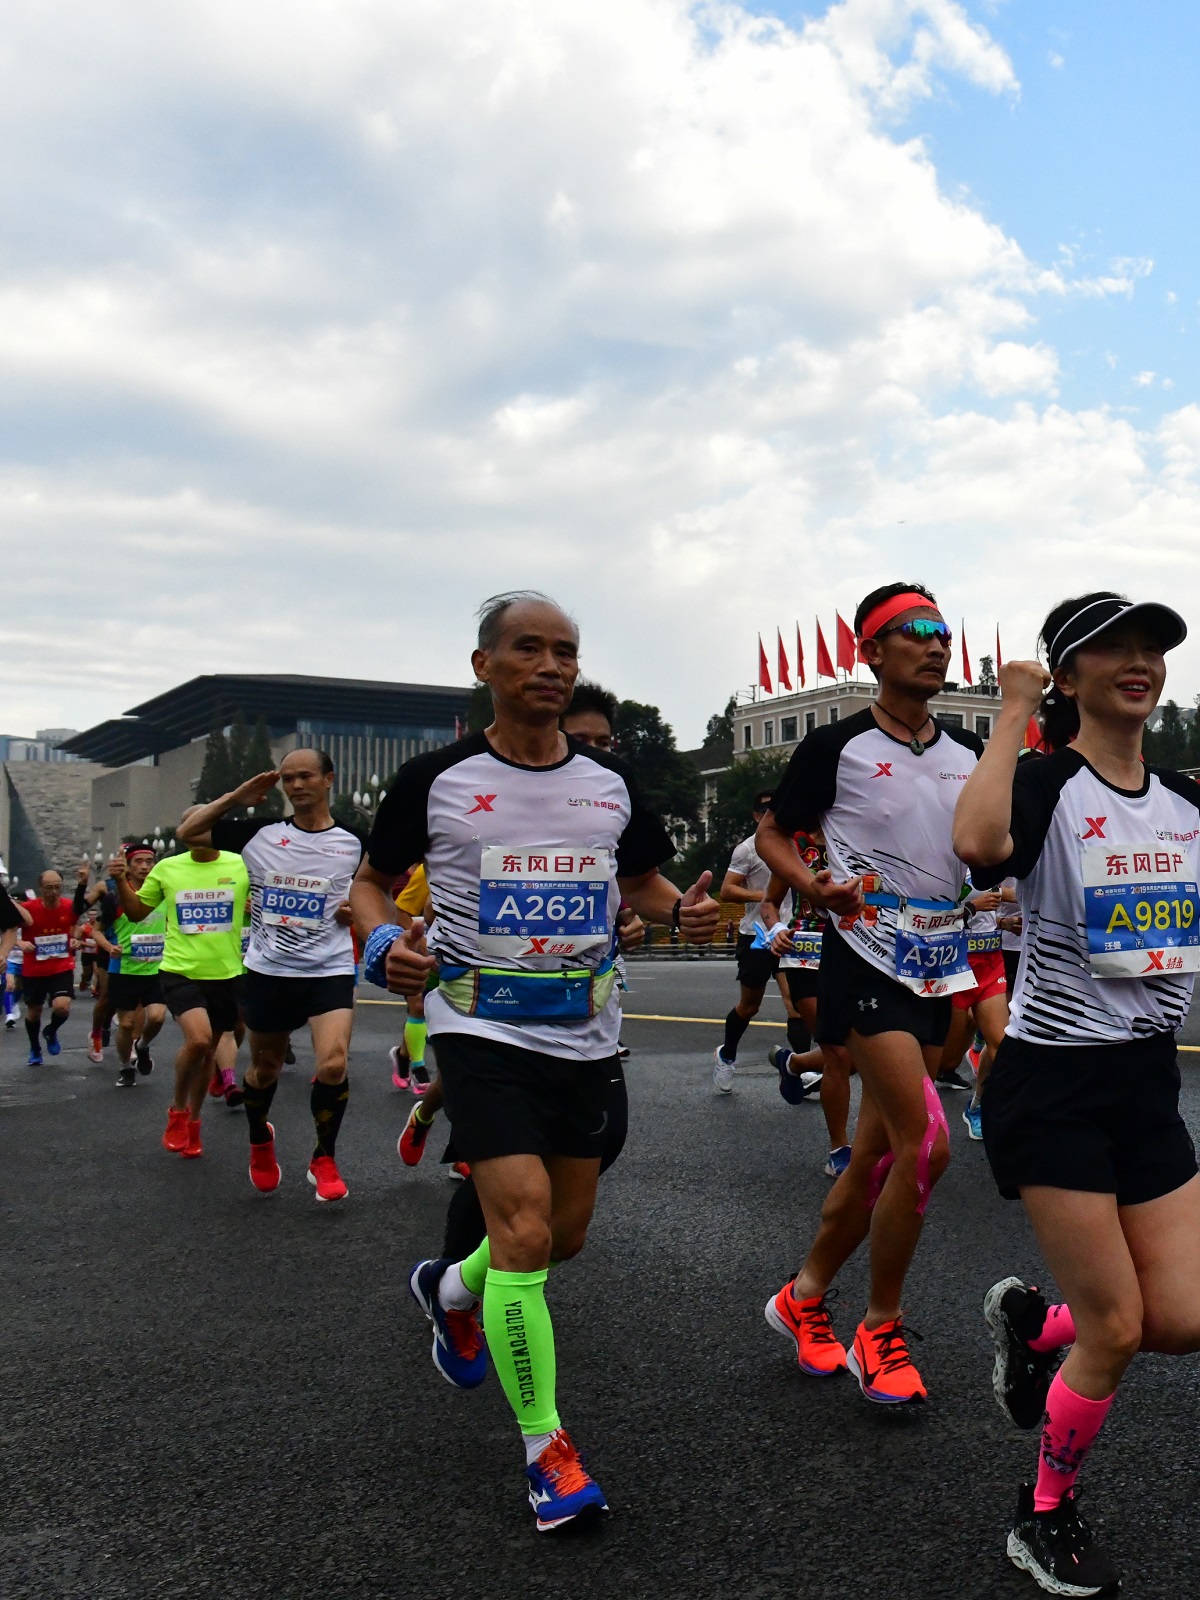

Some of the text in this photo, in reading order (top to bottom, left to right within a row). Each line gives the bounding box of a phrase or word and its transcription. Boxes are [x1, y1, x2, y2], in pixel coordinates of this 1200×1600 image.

[502, 855, 596, 873] 东风日产
[1106, 853, 1183, 875] 东风日产
[274, 876, 321, 888] 东风日产
[266, 894, 320, 912] B1070
[496, 896, 594, 920] A2621
[182, 907, 227, 919] B0313
[1106, 900, 1194, 934] A9819
[868, 941, 887, 958] 2019
[968, 937, 1000, 950] B9729
[505, 1301, 535, 1408] YOURPOWERSUCK
